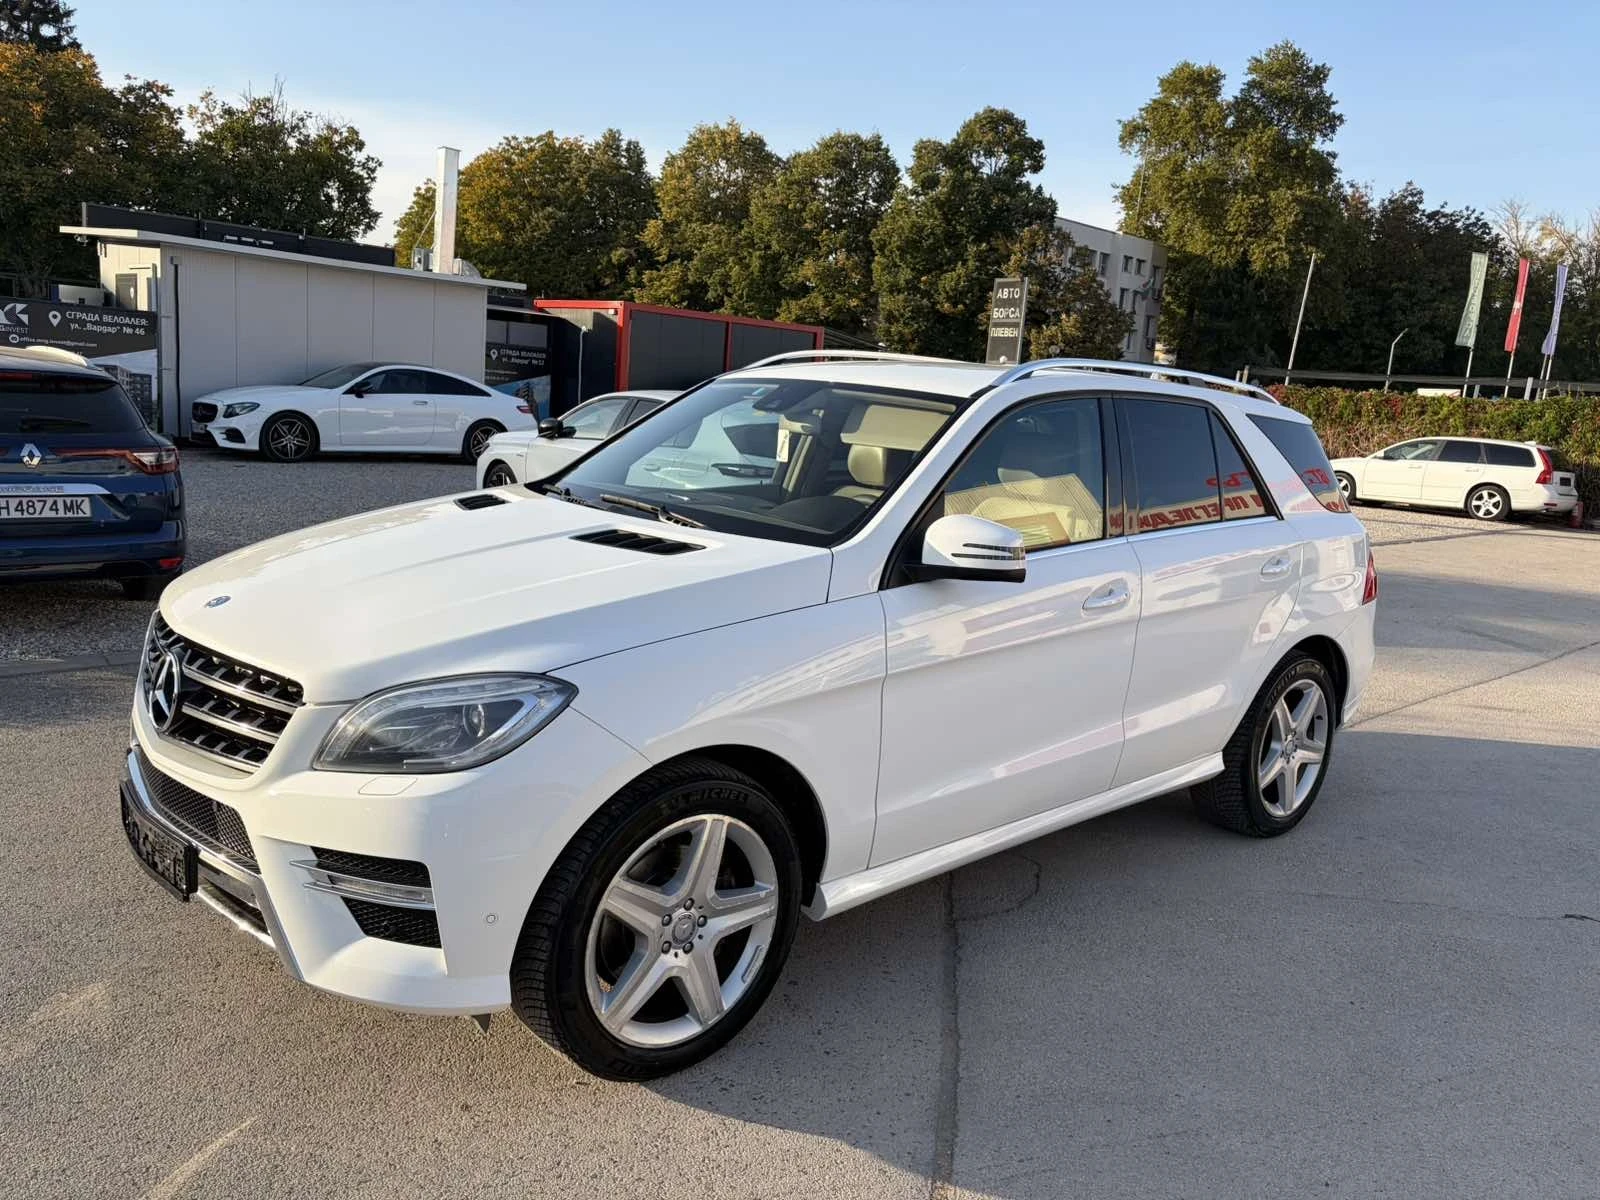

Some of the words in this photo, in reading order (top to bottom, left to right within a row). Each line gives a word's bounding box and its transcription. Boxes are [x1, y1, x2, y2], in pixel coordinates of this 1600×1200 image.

[996, 288, 1020, 299] АВТО
[66, 311, 100, 322] СГРАДА
[102, 314, 149, 326] ВЕЛОАЛЕЯ:
[993, 307, 1020, 319] БОРСА
[70, 322, 81, 330] ул.
[134, 328, 146, 336] 46
[990, 327, 1018, 337] ПЛЕВЕН
[14, 499, 60, 516] 4874
[63, 499, 87, 516] MK
